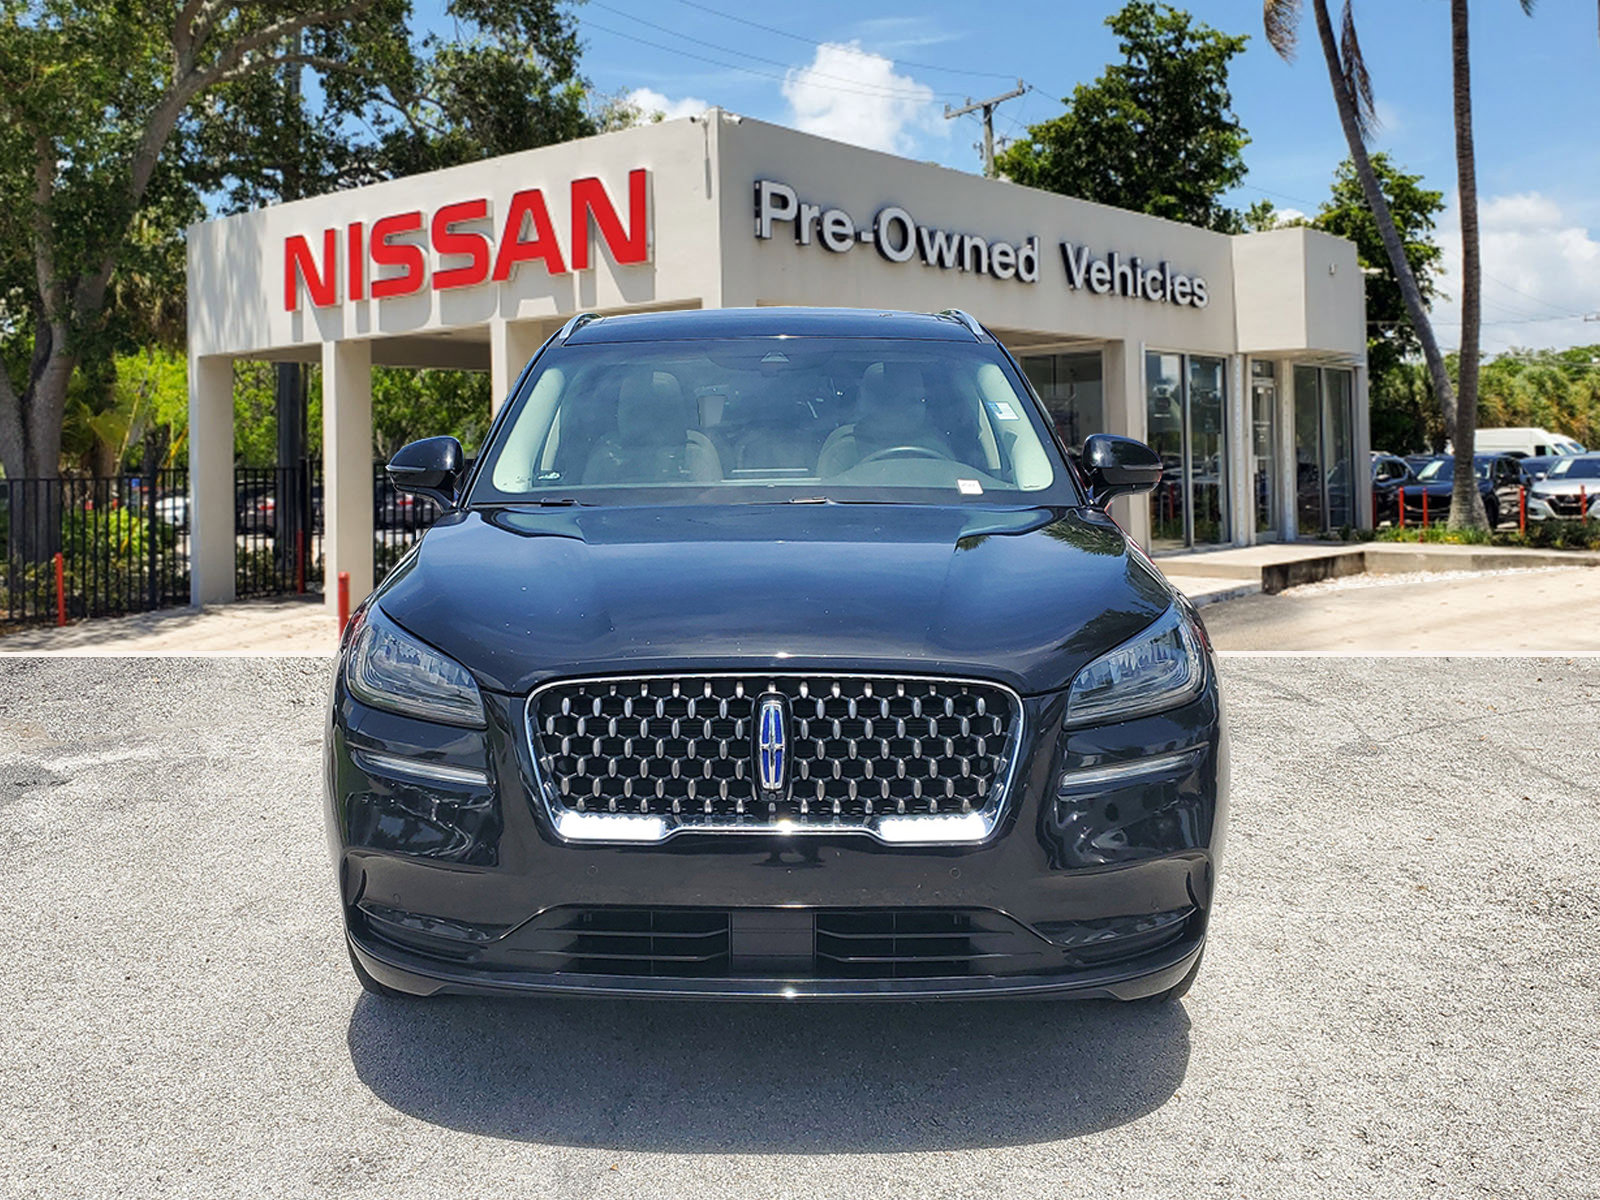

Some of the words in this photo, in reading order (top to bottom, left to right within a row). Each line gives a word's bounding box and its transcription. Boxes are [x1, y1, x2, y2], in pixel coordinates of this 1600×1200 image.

[285, 168, 648, 312] NISSAN
[755, 180, 1039, 283] Pre-Owned
[1061, 242, 1208, 308] Vehicles
